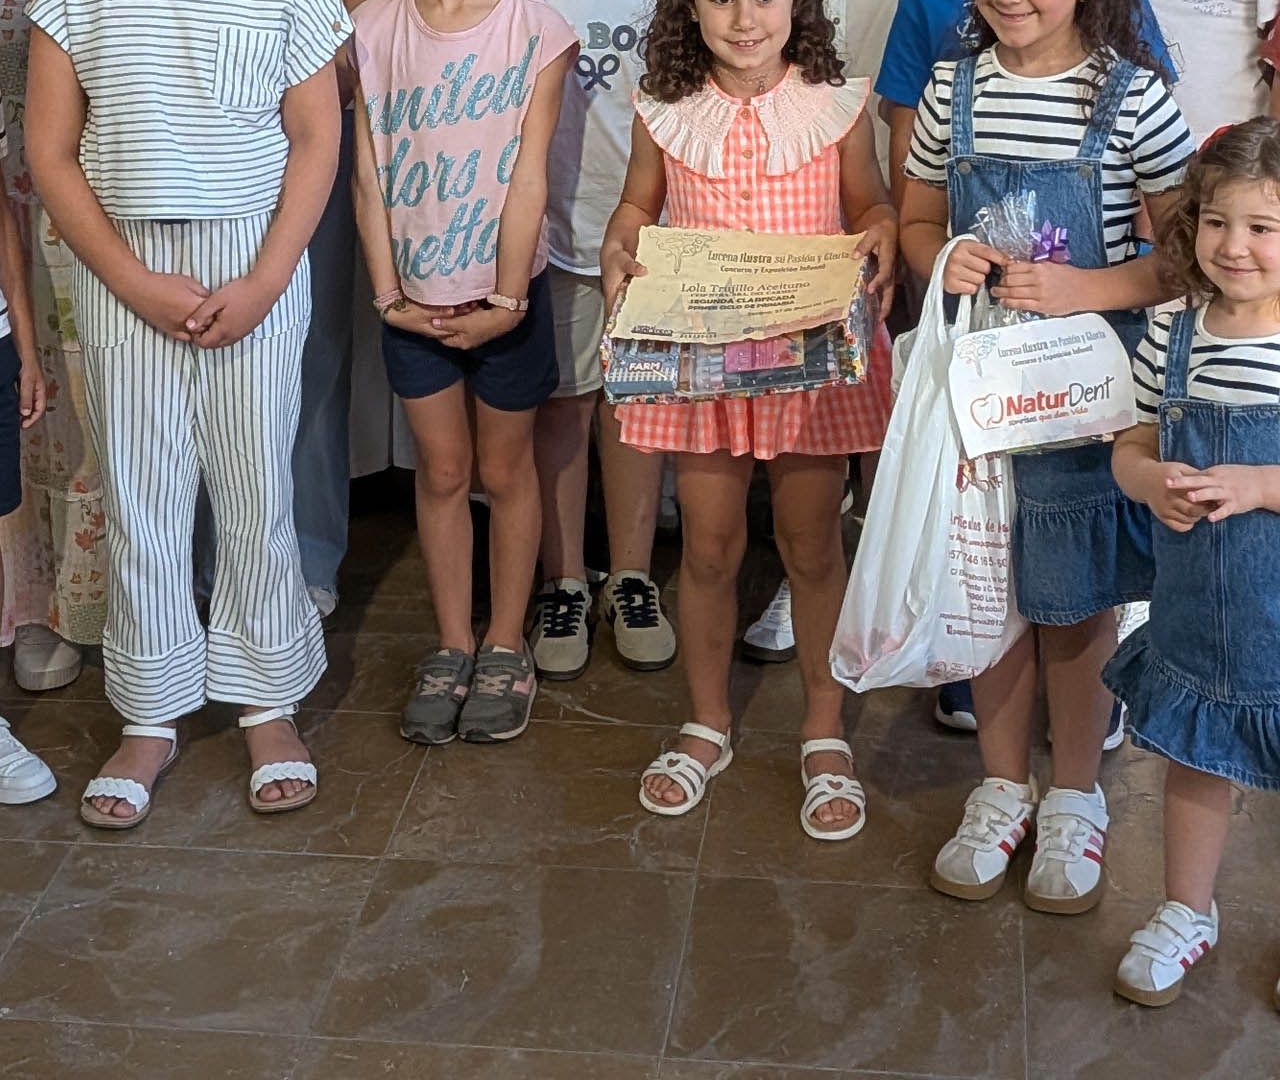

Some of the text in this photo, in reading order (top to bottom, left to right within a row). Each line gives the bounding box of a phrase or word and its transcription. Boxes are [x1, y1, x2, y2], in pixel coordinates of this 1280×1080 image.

[708, 250, 738, 263] Lucena
[680, 282, 810, 294] Lola Trujillo Aceituno
[1006, 376, 1115, 417] NaturDent
